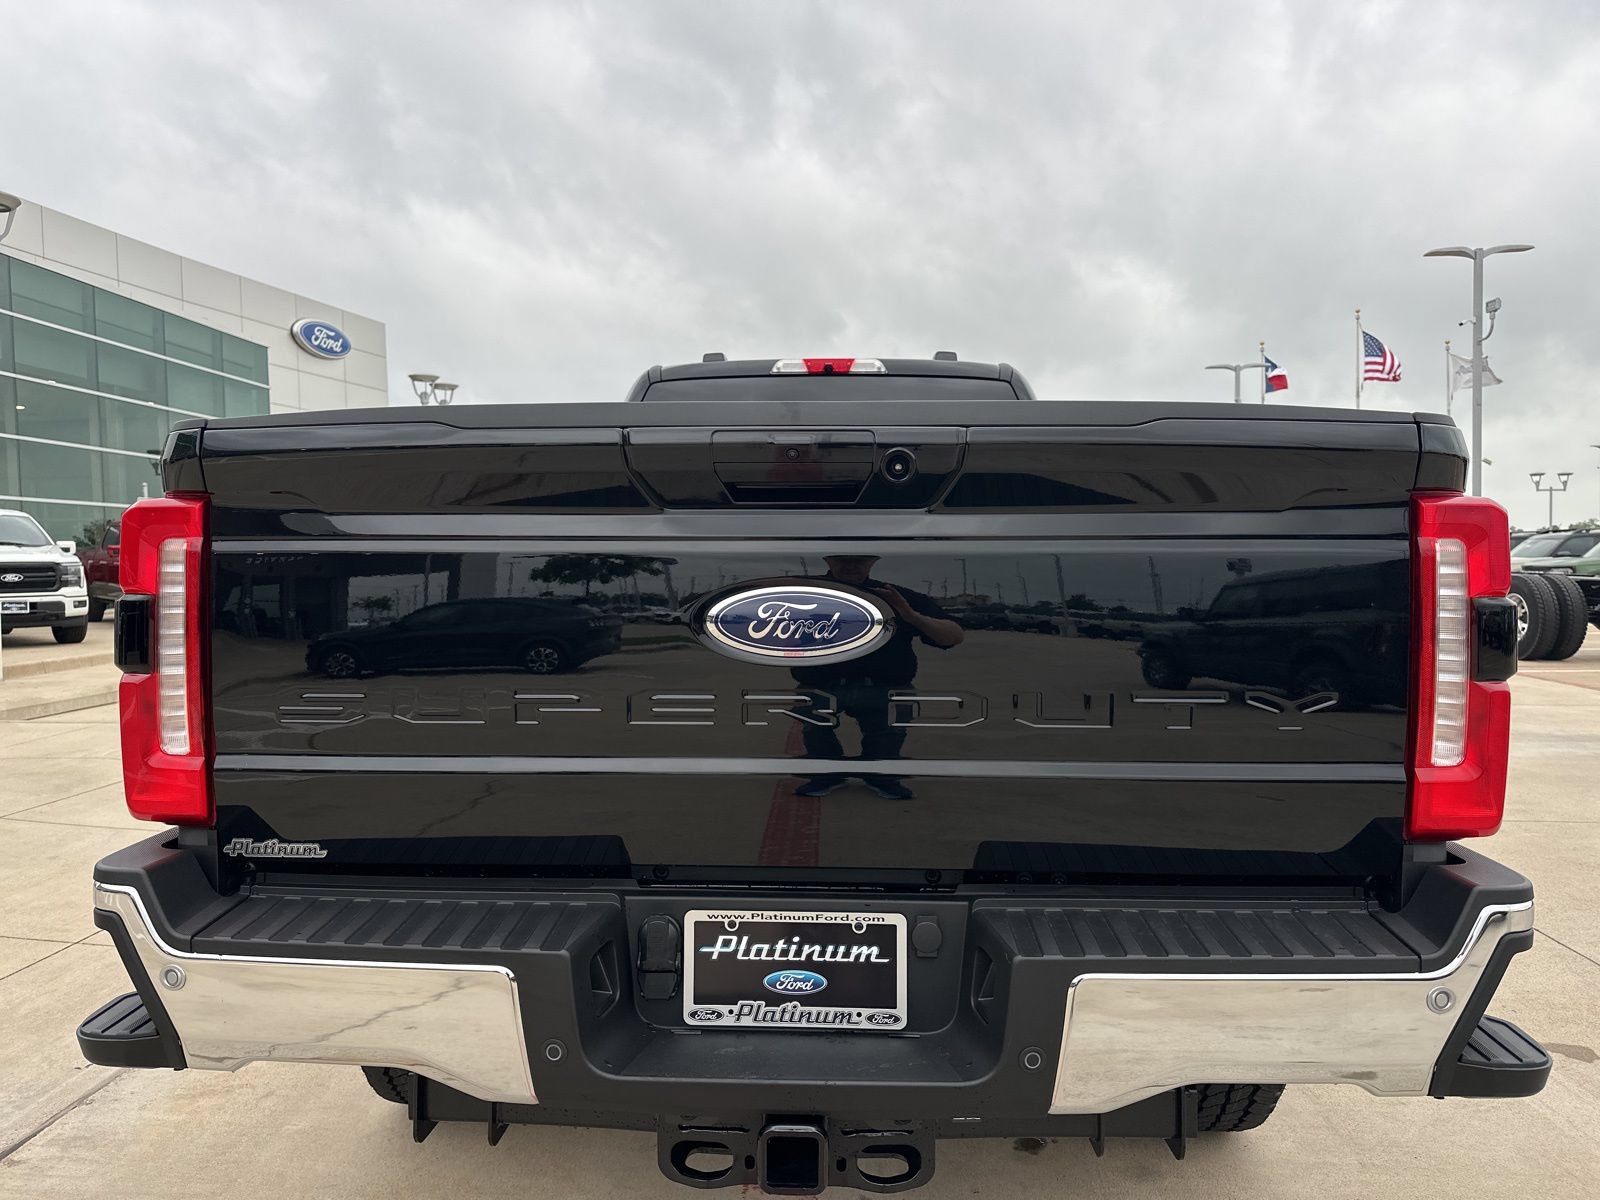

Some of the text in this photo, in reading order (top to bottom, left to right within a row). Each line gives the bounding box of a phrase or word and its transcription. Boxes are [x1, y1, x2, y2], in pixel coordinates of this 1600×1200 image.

[311, 326, 343, 352] Ford
[748, 601, 841, 640] Ford
[278, 689, 1339, 731] SUPER DUTY
[223, 838, 328, 858] Platinum
[707, 912, 886, 923] www.PlatinumFord.com
[699, 935, 890, 963] Platinum
[776, 973, 814, 991] Ford
[695, 1002, 895, 1025] Ford Platinum Ford
